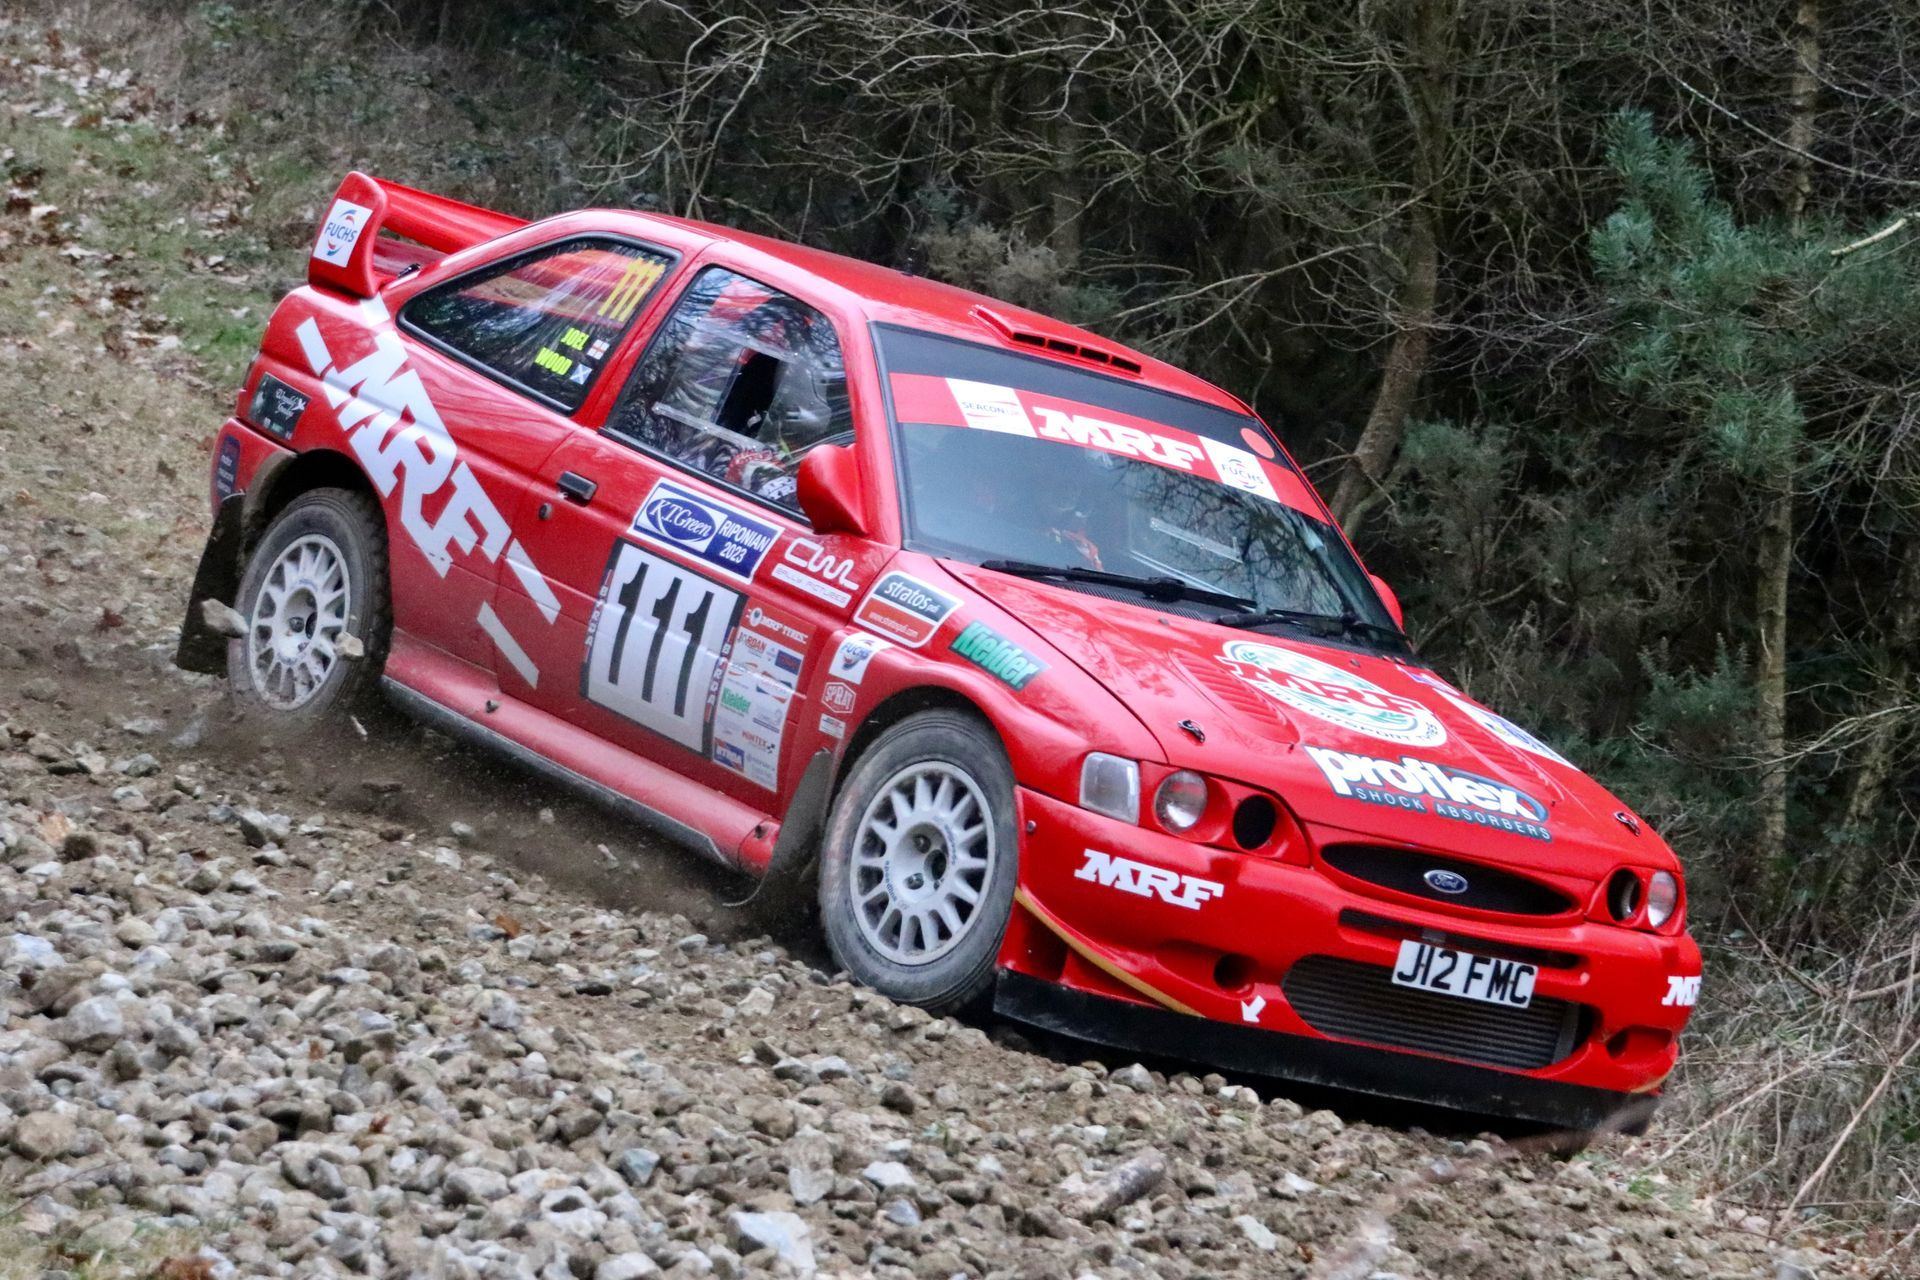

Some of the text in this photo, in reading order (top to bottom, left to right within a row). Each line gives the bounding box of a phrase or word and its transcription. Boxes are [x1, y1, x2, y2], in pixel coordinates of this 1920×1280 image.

[325, 222, 358, 243] FUCHS
[597, 256, 666, 322] 111
[560, 327, 590, 351] JOEL
[534, 346, 573, 376] WOOD
[1033, 406, 1205, 470] MRF
[321, 330, 512, 579] MRF
[1221, 463, 1264, 485] FUCHS
[719, 520, 771, 552] RIPONIAN
[719, 542, 747, 564] 2023
[884, 581, 932, 611] stratos
[608, 561, 715, 718] 111
[825, 685, 854, 711] SPRAY
[1303, 745, 1541, 822] proflex
[1356, 787, 1551, 840] SHOCK ABSORBERS
[1074, 848, 1224, 910] MRF
[1434, 872, 1460, 890] Ford
[1463, 956, 1535, 1005] FMC
